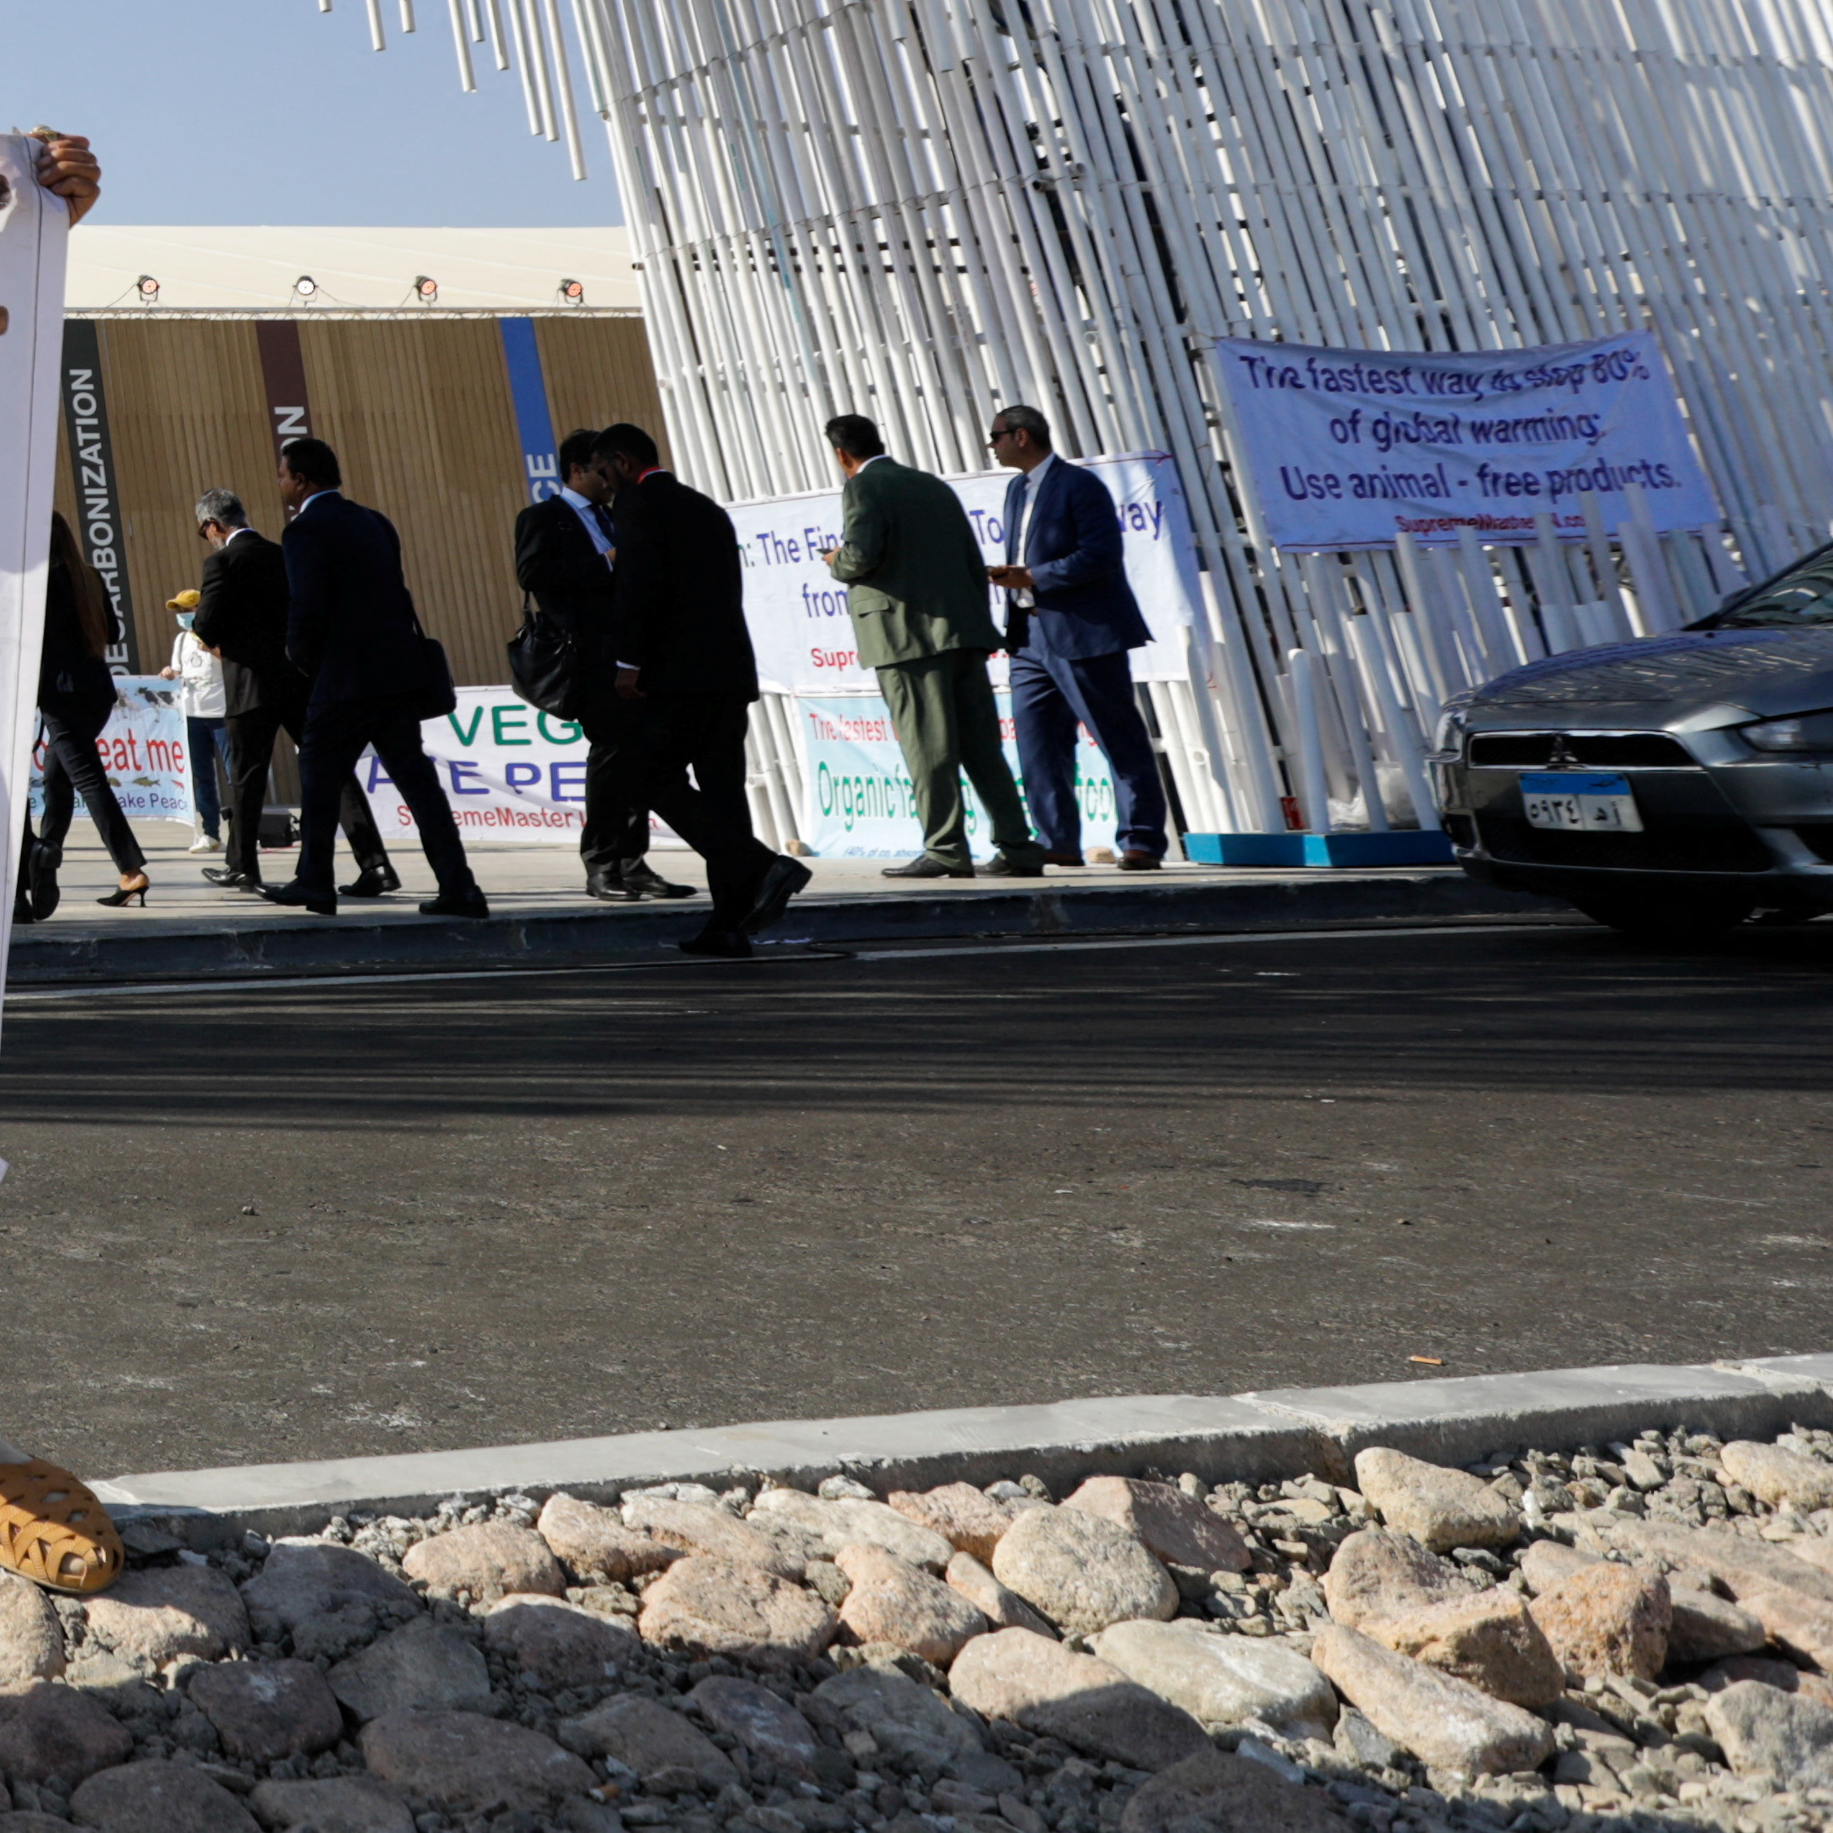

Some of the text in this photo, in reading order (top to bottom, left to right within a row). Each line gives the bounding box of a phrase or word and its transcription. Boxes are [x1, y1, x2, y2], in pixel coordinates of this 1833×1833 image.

[1306, 357, 1418, 396] fastest
[1420, 370, 1485, 402] way
[1525, 363, 1584, 394] stop
[1330, 408, 1363, 445] of
[1372, 410, 1461, 453] global
[1279, 465, 1343, 502] Use
[1347, 463, 1452, 501] animal
[1474, 463, 1541, 498] free
[756, 530, 802, 566] The
[809, 713, 838, 741] The
[95, 728, 143, 771] eat
[146, 738, 186, 774] me
[119, 793, 145, 809] ake
[818, 761, 896, 833] Organic
